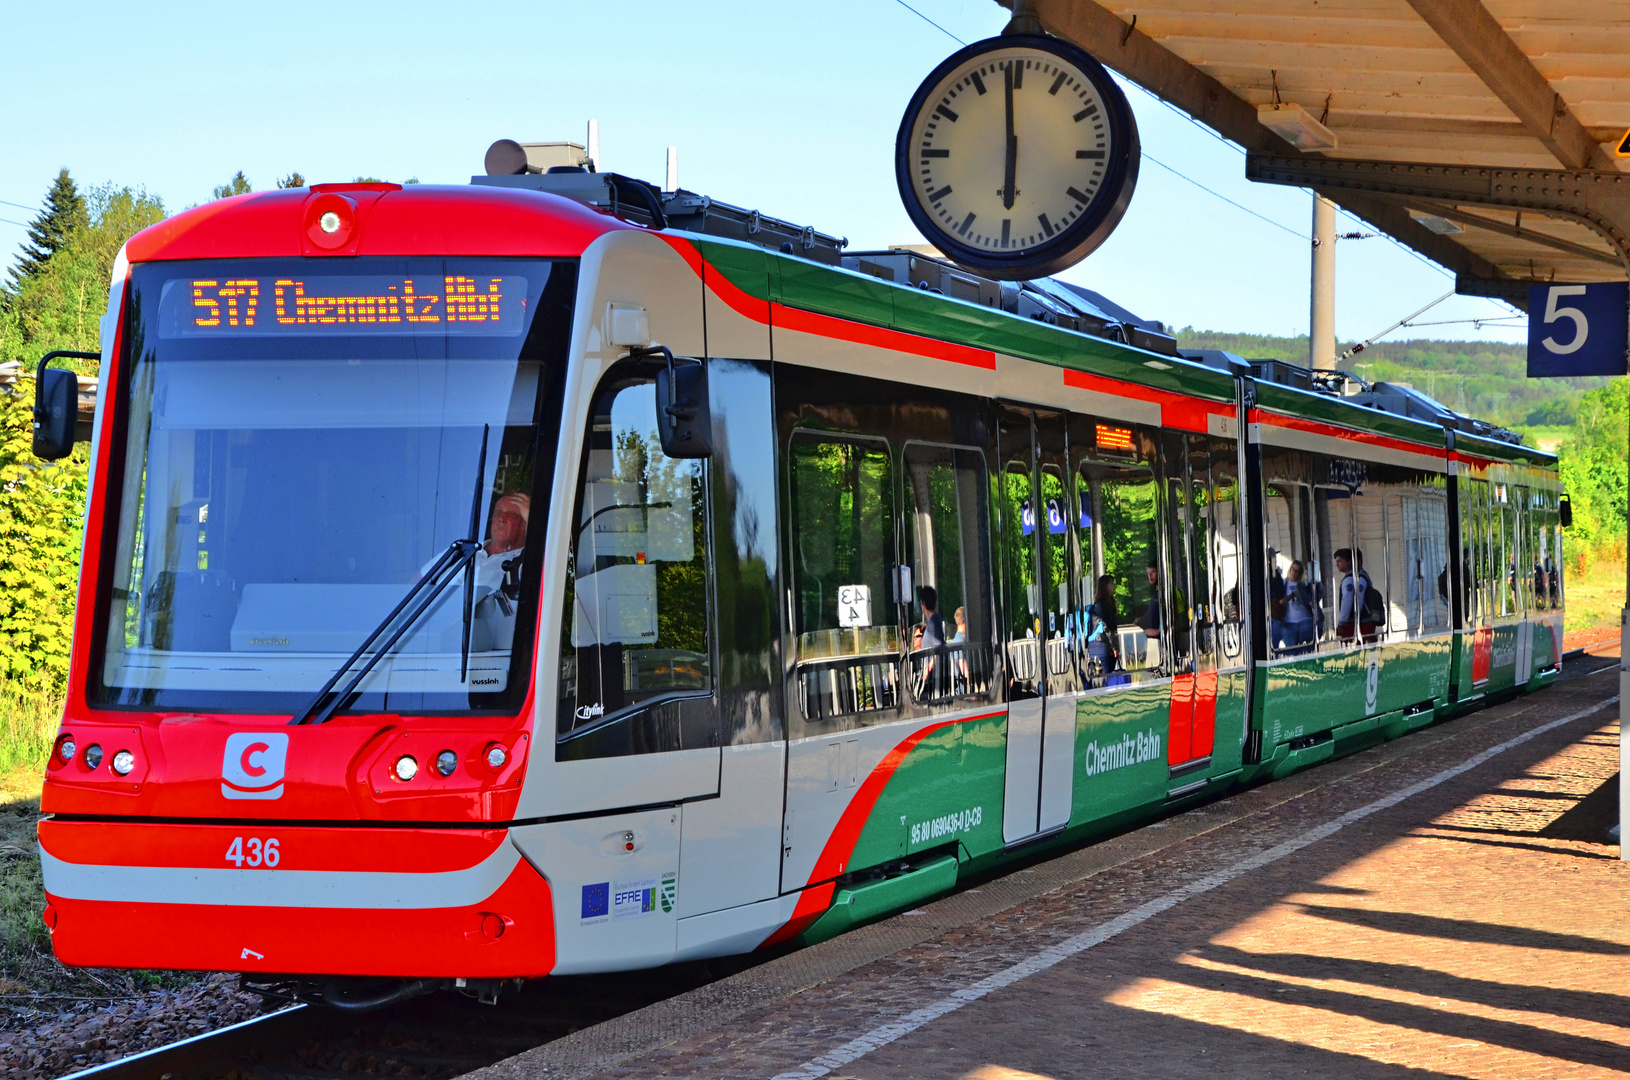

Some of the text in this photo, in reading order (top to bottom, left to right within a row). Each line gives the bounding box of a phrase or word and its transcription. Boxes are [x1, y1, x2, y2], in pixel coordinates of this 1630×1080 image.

[275, 279, 440, 323] Chemnitz
[445, 275, 503, 322] Hbf
[1541, 285, 1589, 355] 5
[576, 702, 605, 719] Citylink
[1086, 727, 1161, 777] Chemnitz Bahn
[911, 823, 921, 845] 95
[921, 820, 931, 842] 80
[964, 806, 982, 833] D-CB
[225, 836, 280, 868] 436
[615, 890, 641, 905] EFRE
